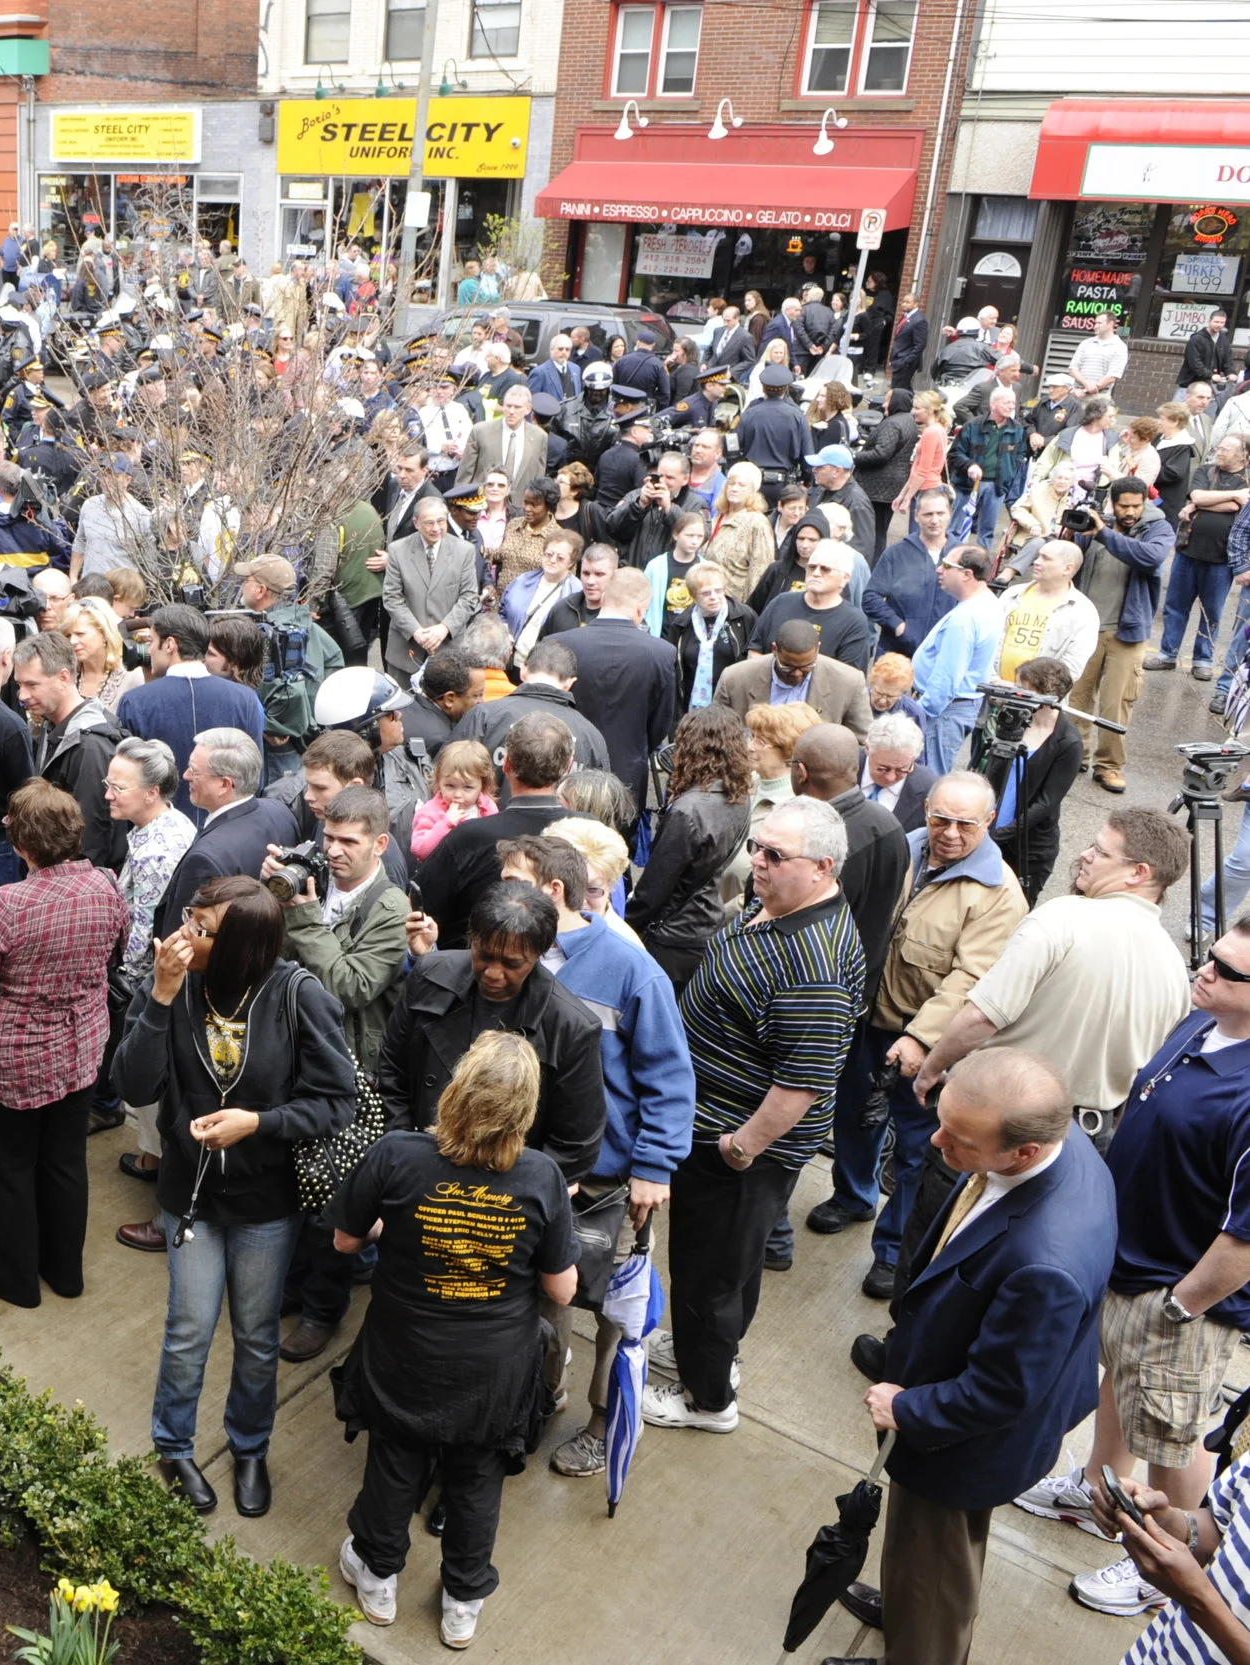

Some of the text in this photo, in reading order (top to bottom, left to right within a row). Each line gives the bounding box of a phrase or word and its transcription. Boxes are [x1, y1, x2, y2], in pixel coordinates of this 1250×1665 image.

[94, 124, 124, 134] STEEL
[127, 124, 151, 134] CITY
[320, 122, 505, 142] STEEL CITY
[348, 146, 460, 159] UNIFOR INC.
[560, 202, 851, 228] PANINI ESPRESSO CAPPUCCINO GELATO DOLCI
[643, 236, 667, 251] FRESH
[1177, 263, 1225, 277] TURKEY
[1071, 269, 1133, 286] HOMEMADE
[1076, 285, 1117, 300] PASTA
[1061, 315, 1120, 332] SAUS
[1163, 310, 1207, 324] JUMBO
[1007, 613, 1031, 627] OLD
[1014, 627, 1042, 647] 55
[465, 1186, 513, 1206] Memory
[418, 1205, 446, 1215] OFFICER
[448, 1209, 466, 1217] PAUL
[414, 1213, 443, 1223] OFFICER
[444, 1218, 475, 1227] STEPHEN
[423, 1224, 452, 1233] OFFICER
[471, 1230, 493, 1238] KELLY
